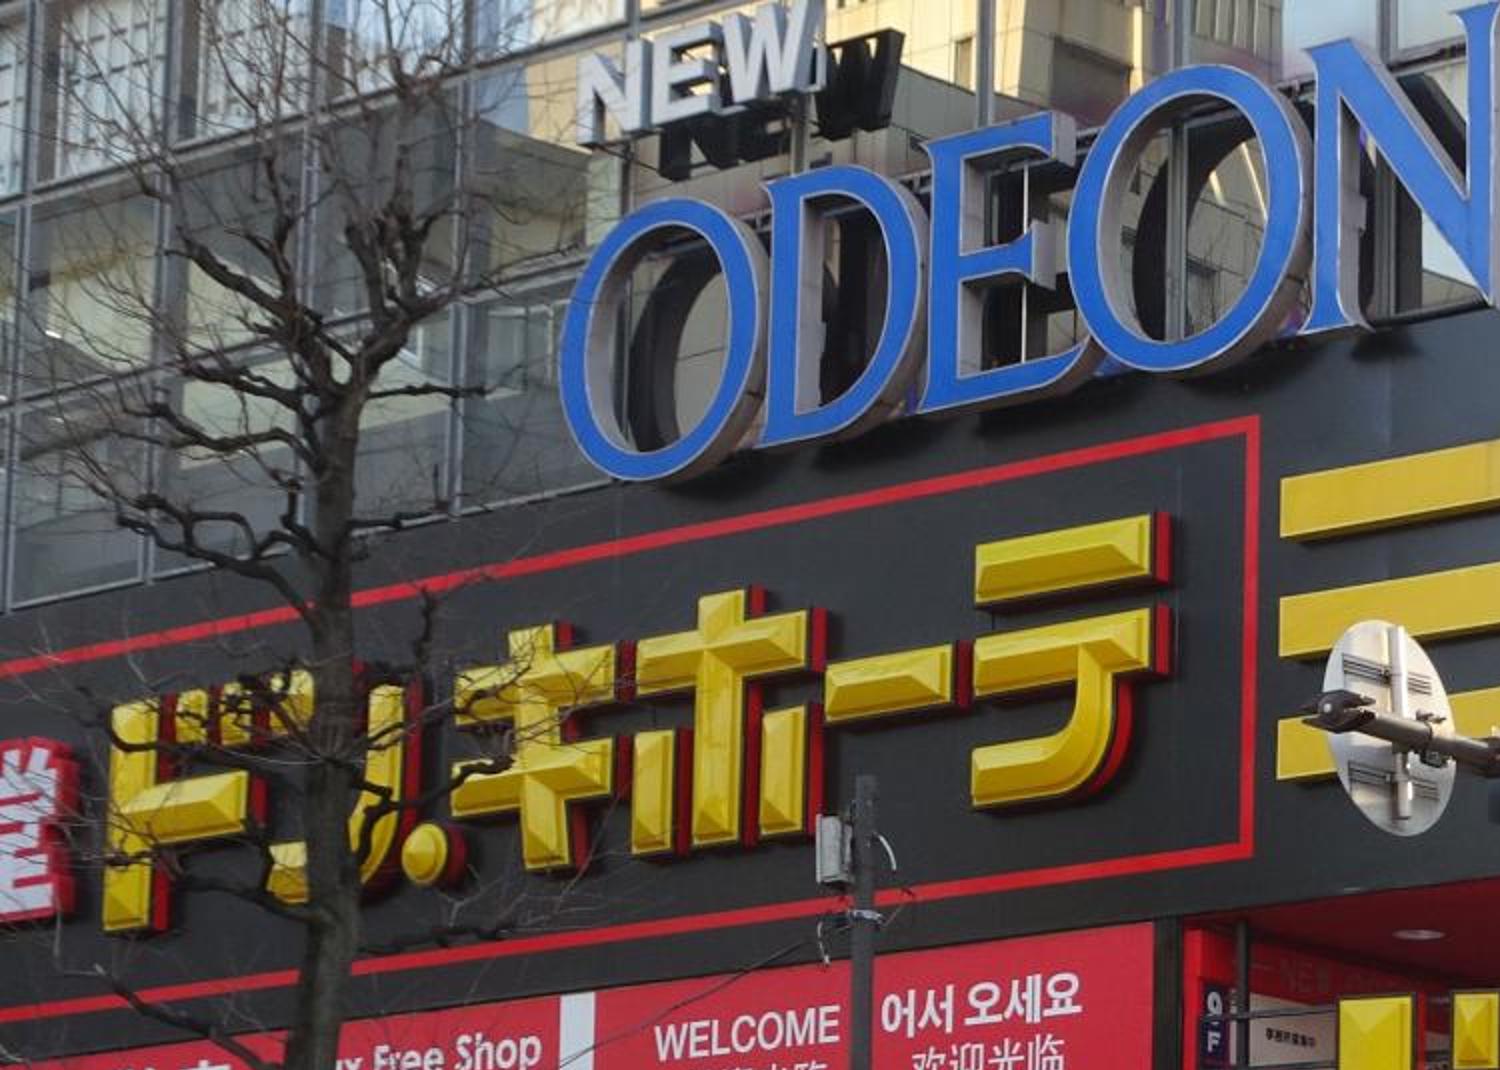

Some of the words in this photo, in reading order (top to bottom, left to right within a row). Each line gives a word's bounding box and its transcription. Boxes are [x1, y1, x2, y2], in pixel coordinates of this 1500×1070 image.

[578, 0, 826, 146] NEW
[654, 1005, 840, 1062] WELCOME
[881, 989, 953, 1038] 어서
[964, 972, 1082, 1027] 오세요
